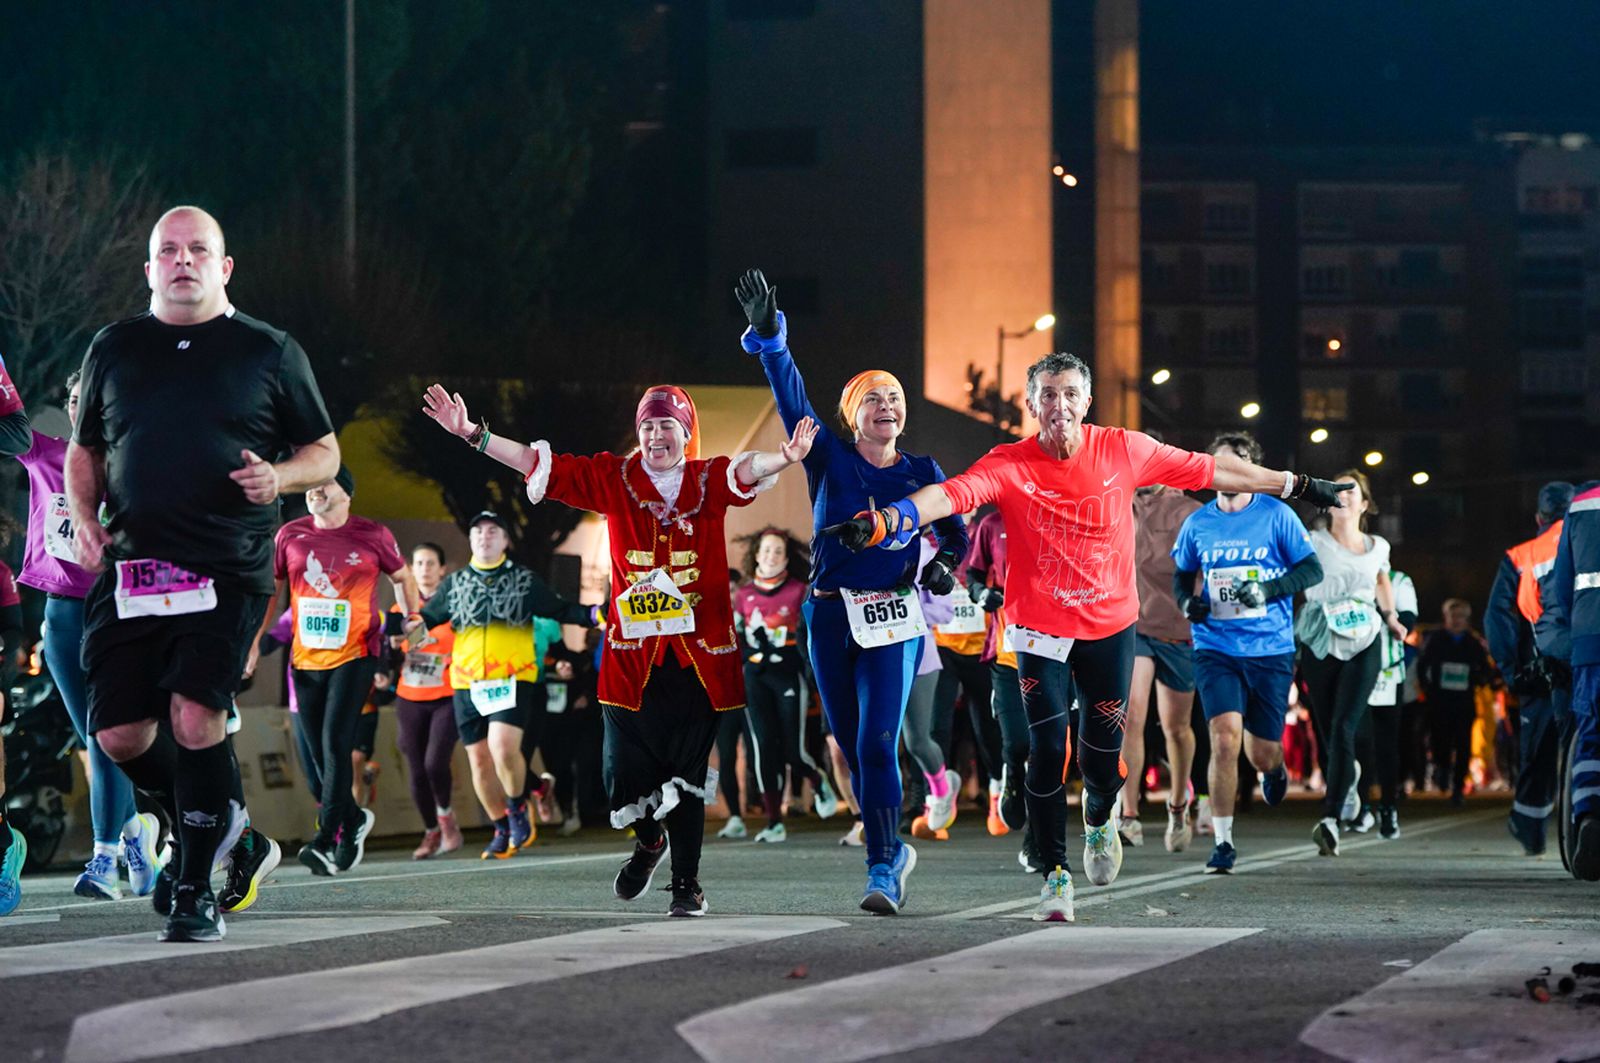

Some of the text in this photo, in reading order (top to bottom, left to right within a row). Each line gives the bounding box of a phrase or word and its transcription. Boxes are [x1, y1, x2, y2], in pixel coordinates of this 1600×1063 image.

[1201, 547, 1268, 563] APOLO
[853, 596, 869, 605] SAN
[863, 598, 908, 625] 6515
[306, 616, 340, 633] 8058
